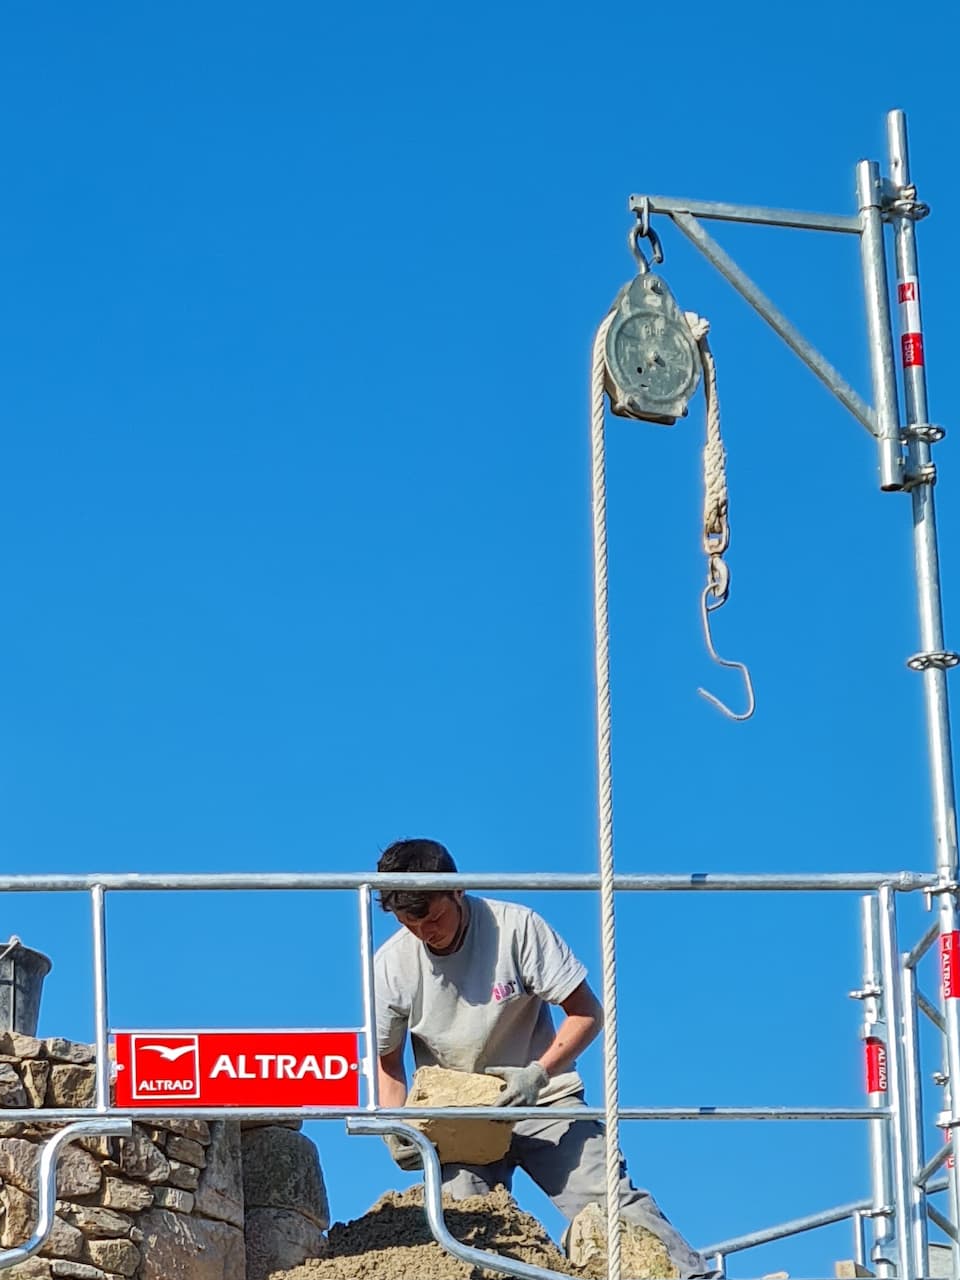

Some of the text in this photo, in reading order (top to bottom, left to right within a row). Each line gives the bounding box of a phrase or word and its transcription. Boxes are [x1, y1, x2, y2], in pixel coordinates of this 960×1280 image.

[942, 952, 951, 997] ALTRAD
[209, 1054, 349, 1080] ALTRAD
[878, 1047, 887, 1090] ALTRAD
[138, 1079, 194, 1091] ALTRAD
